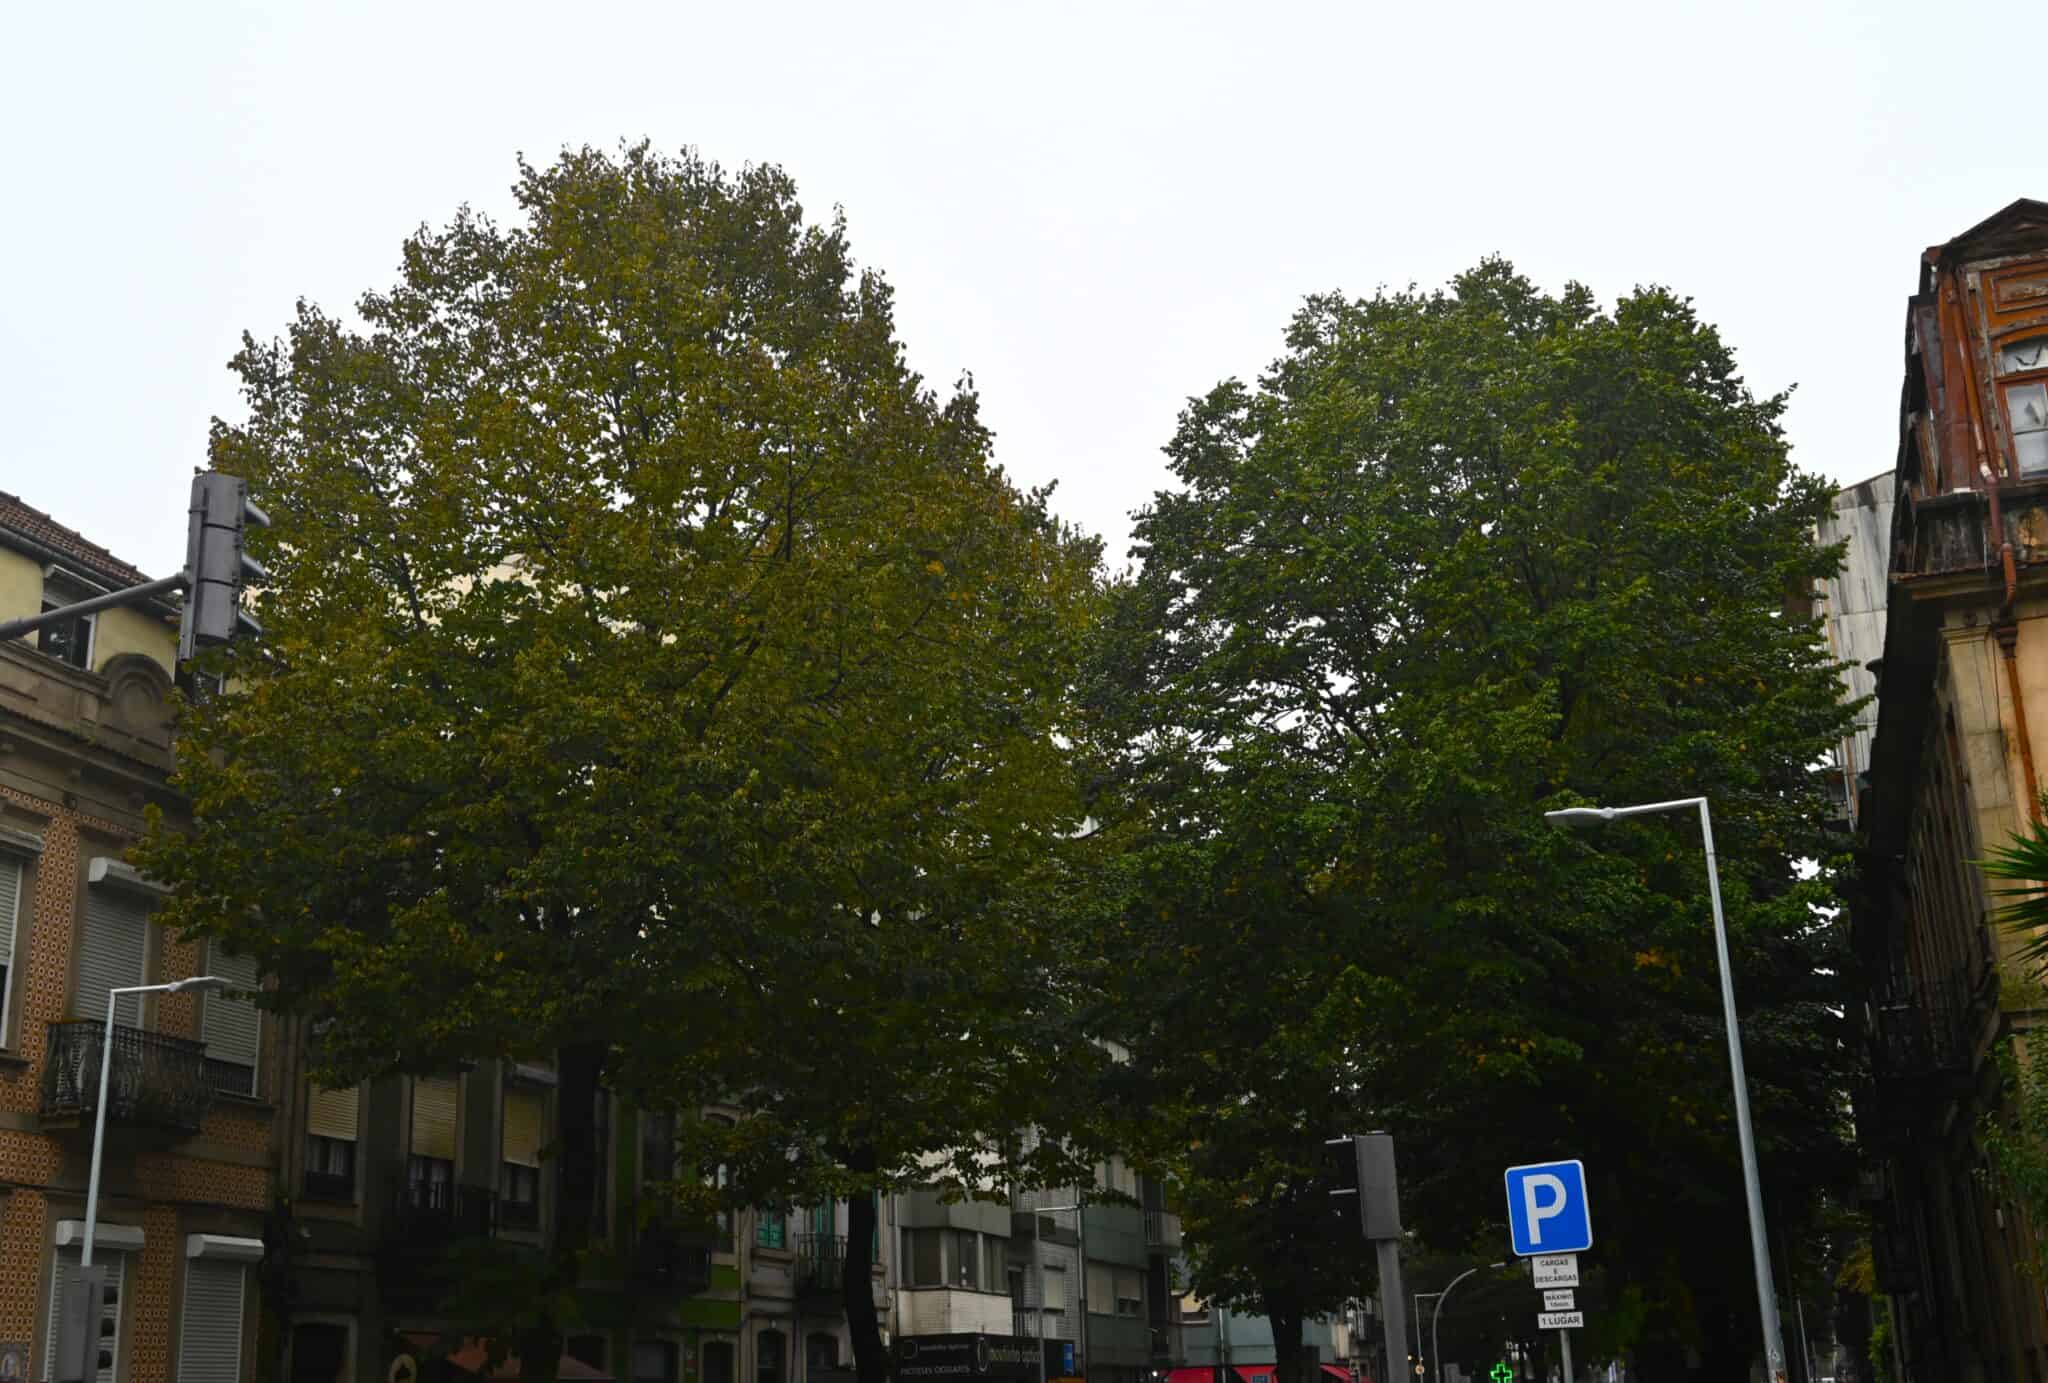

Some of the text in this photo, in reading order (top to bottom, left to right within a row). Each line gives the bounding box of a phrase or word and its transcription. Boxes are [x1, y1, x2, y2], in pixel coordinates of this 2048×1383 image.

[1522, 1174, 1566, 1245] P
[1536, 1274, 1577, 1283] DESCARGAS
[1549, 1316, 1580, 1326] LUGAR
